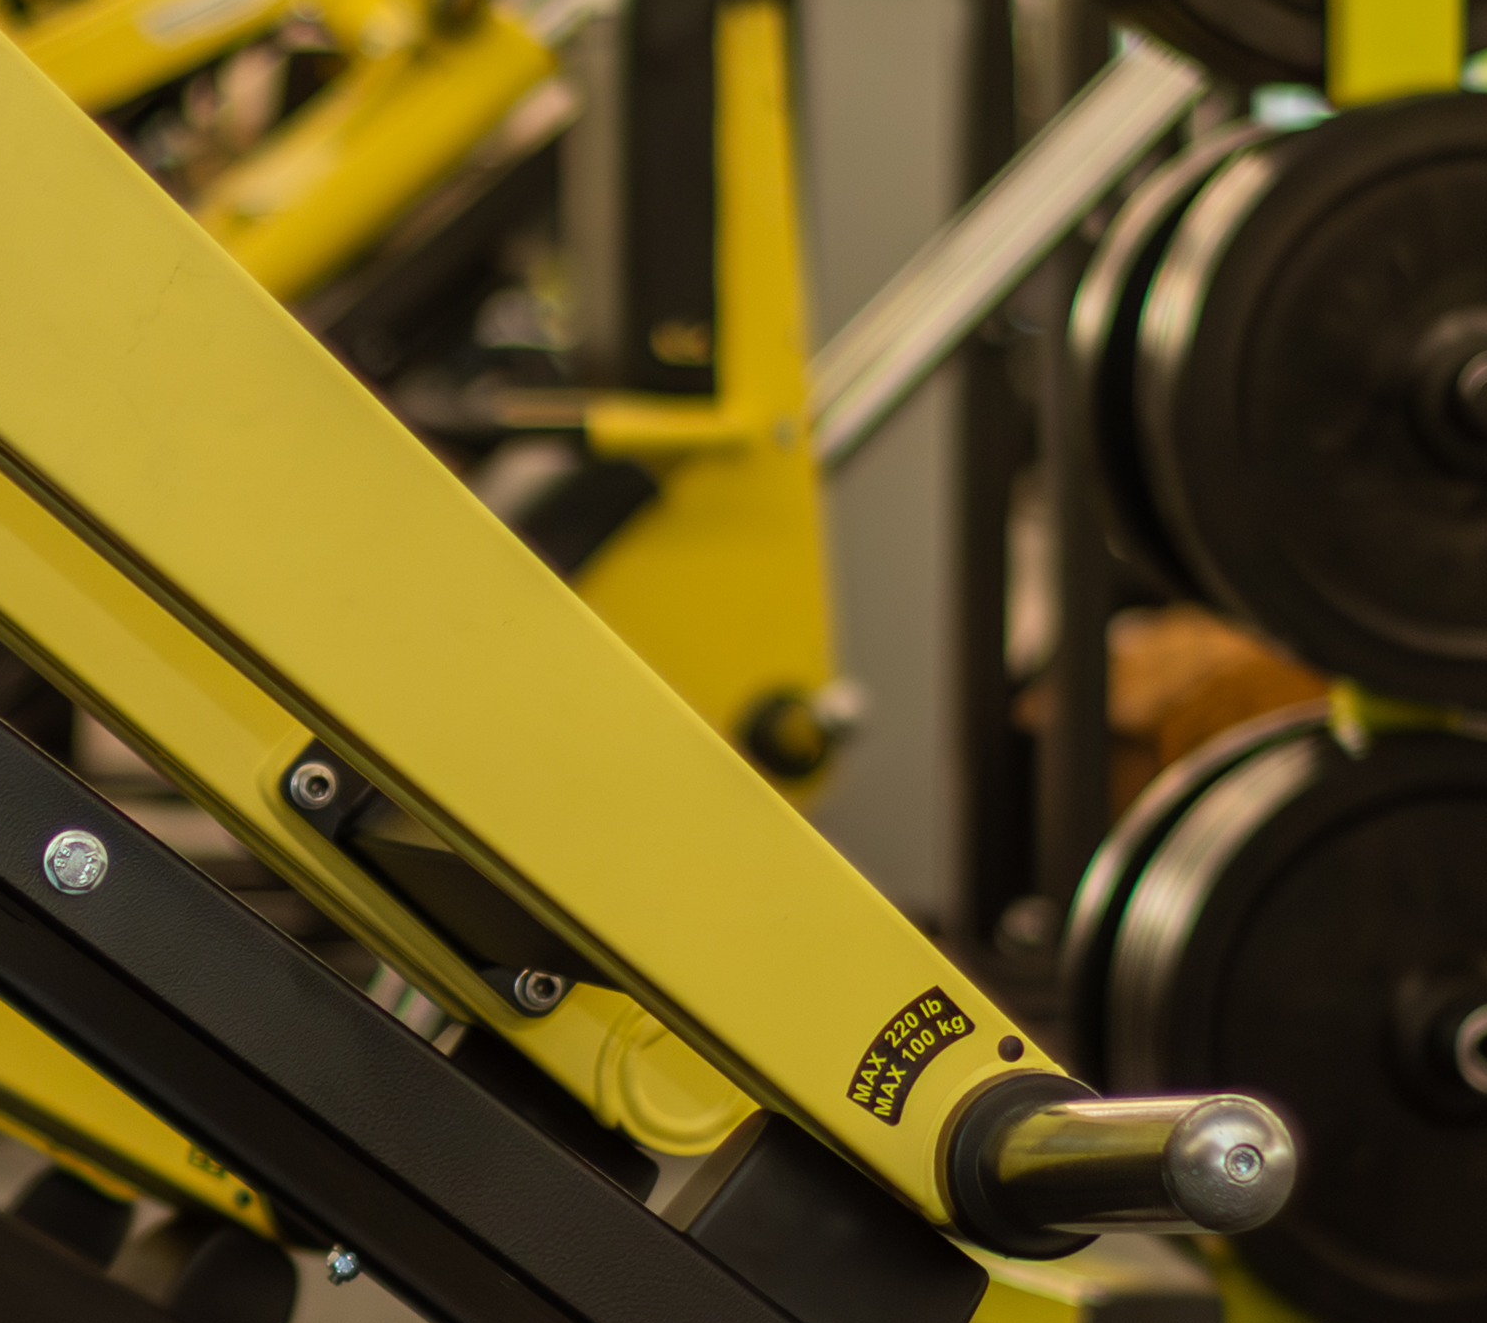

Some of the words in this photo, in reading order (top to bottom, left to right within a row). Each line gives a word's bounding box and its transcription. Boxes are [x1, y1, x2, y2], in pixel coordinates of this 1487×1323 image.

[852, 1051, 887, 1104] MAX
[884, 1010, 920, 1048] 220
[918, 996, 942, 1020] lb
[873, 1064, 907, 1117] MAX
[901, 1027, 937, 1064] 100
[936, 1013, 967, 1039] kg
